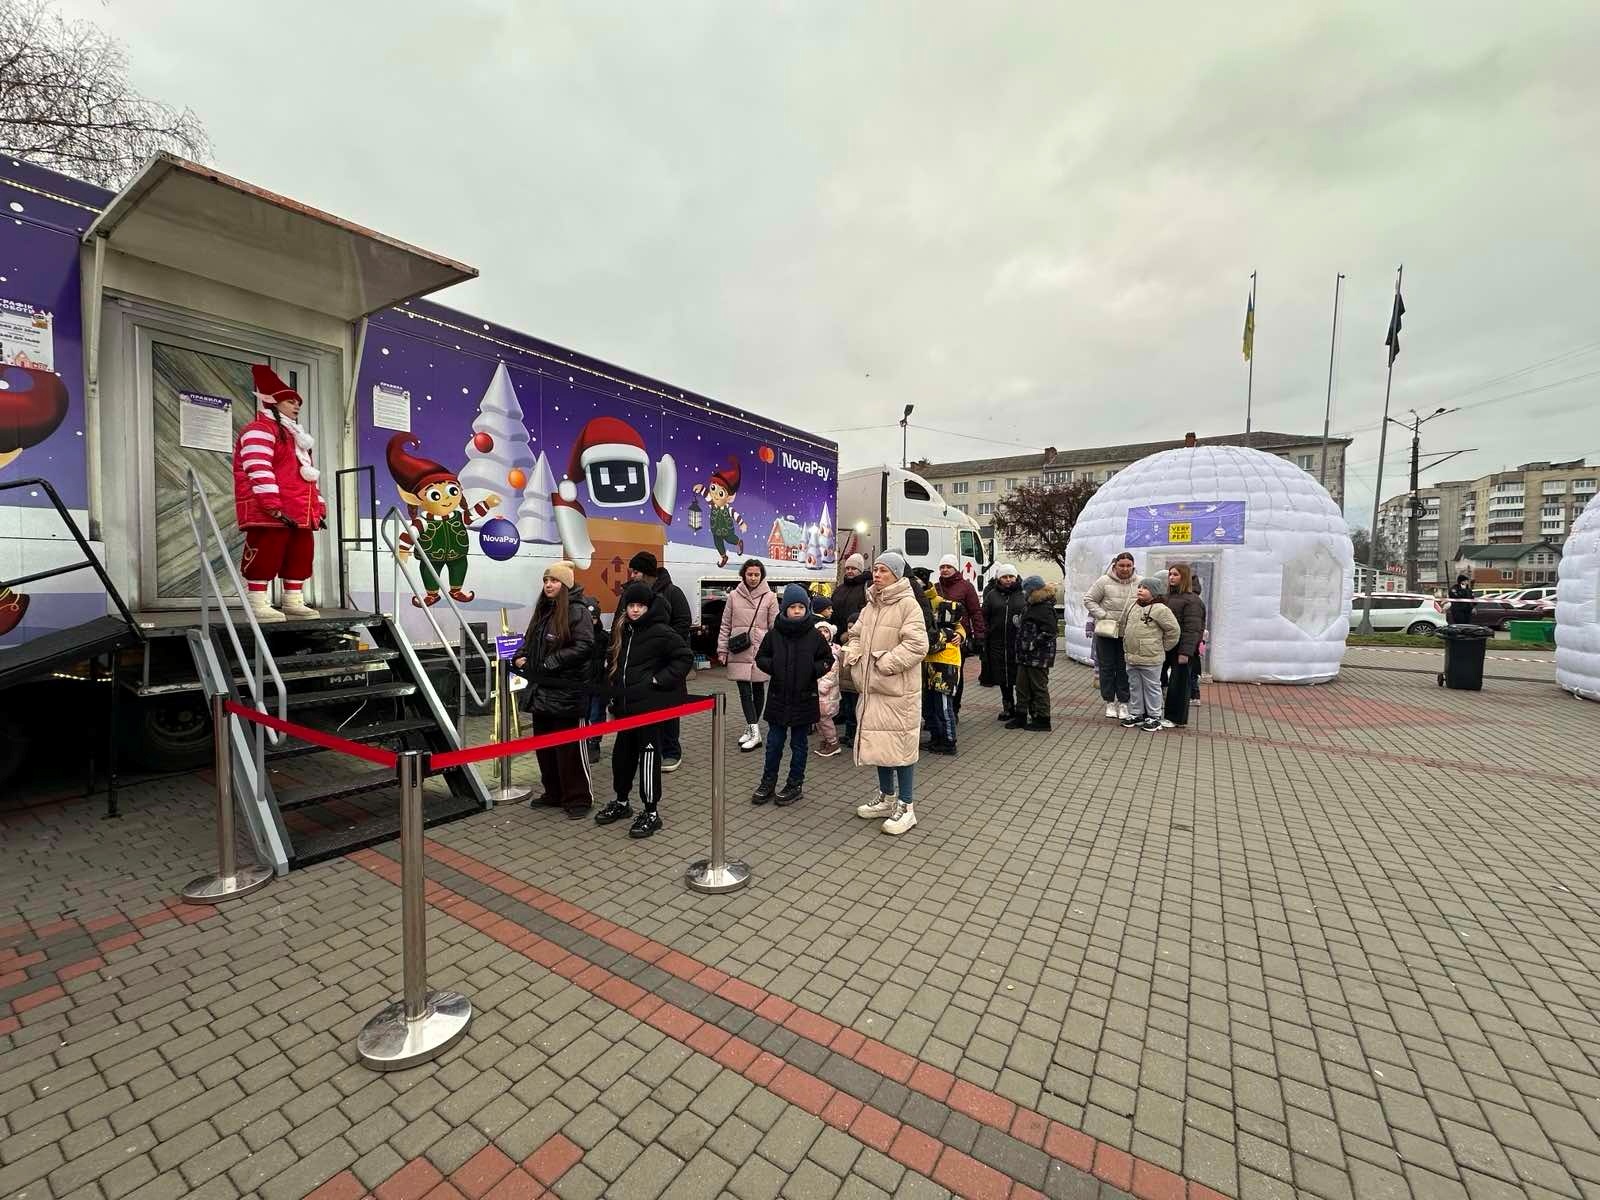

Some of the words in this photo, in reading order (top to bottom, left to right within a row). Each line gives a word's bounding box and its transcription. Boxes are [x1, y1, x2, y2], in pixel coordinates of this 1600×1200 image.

[190, 394, 222, 403] ПРАВИЛА
[782, 452, 830, 481] NovaPay
[483, 534, 519, 545] NovaPay
[330, 673, 366, 684] MAN
